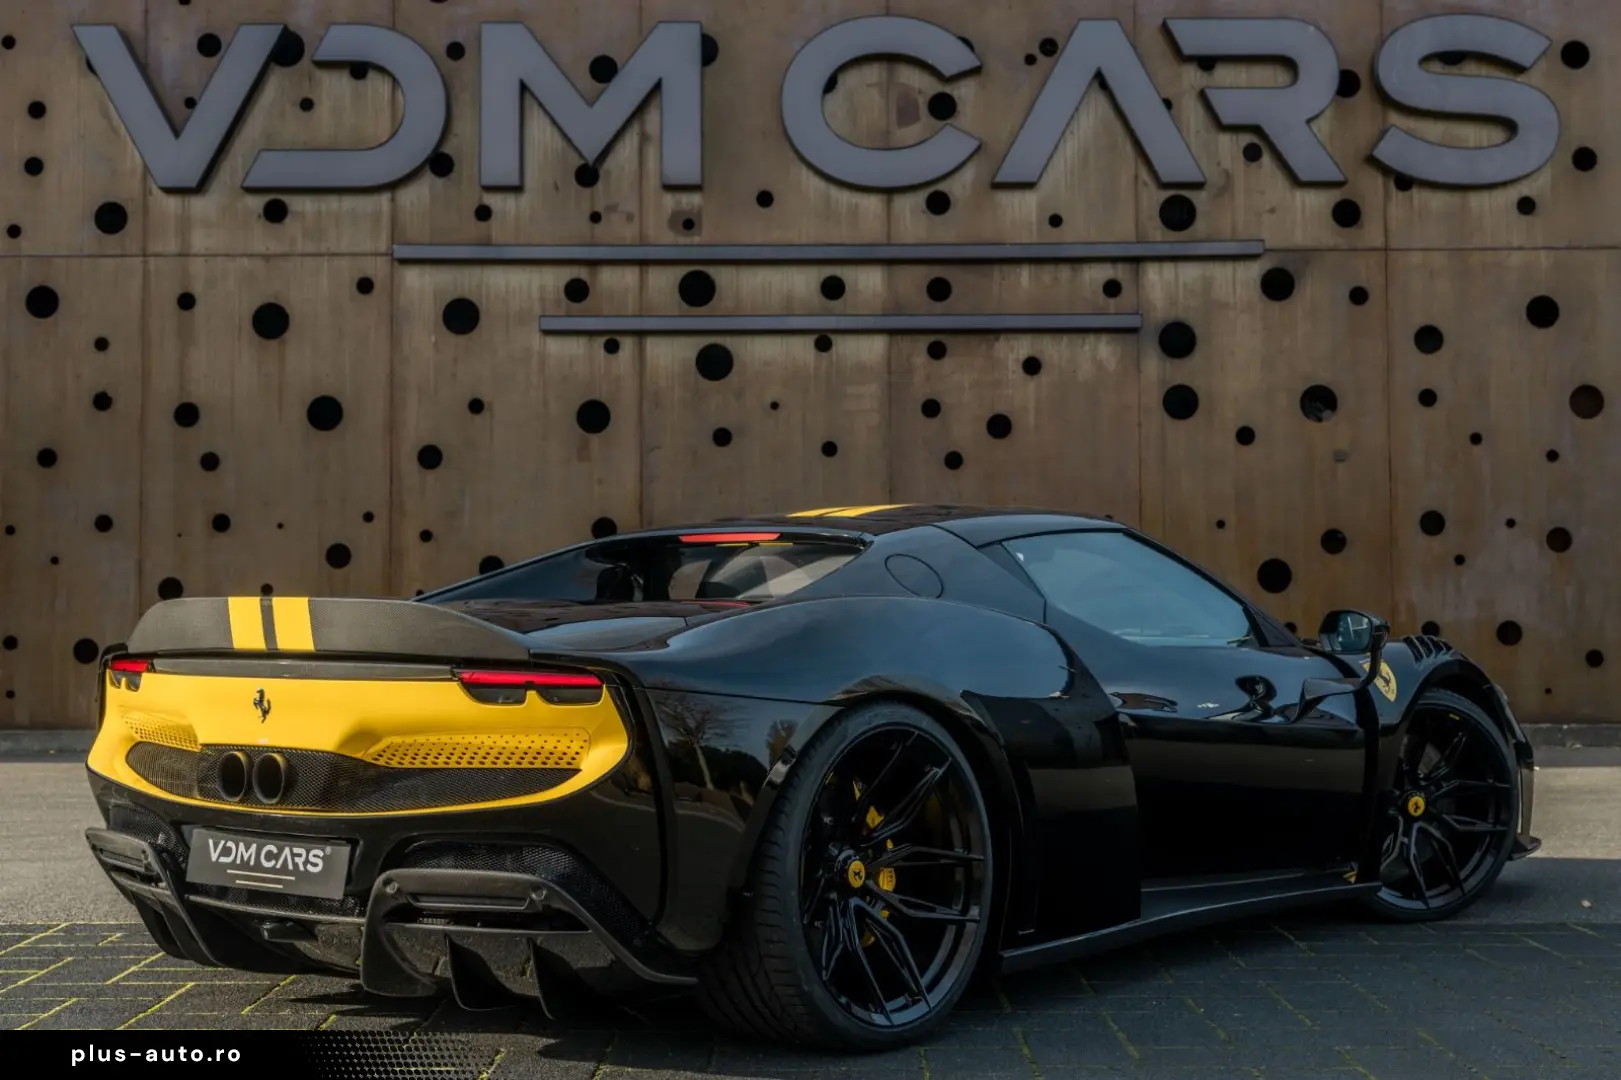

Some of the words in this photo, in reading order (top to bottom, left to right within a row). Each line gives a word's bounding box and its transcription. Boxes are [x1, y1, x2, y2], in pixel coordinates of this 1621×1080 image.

[72, 21, 704, 191] VDM
[781, 14, 1561, 188] CARS
[208, 838, 257, 866] VDM
